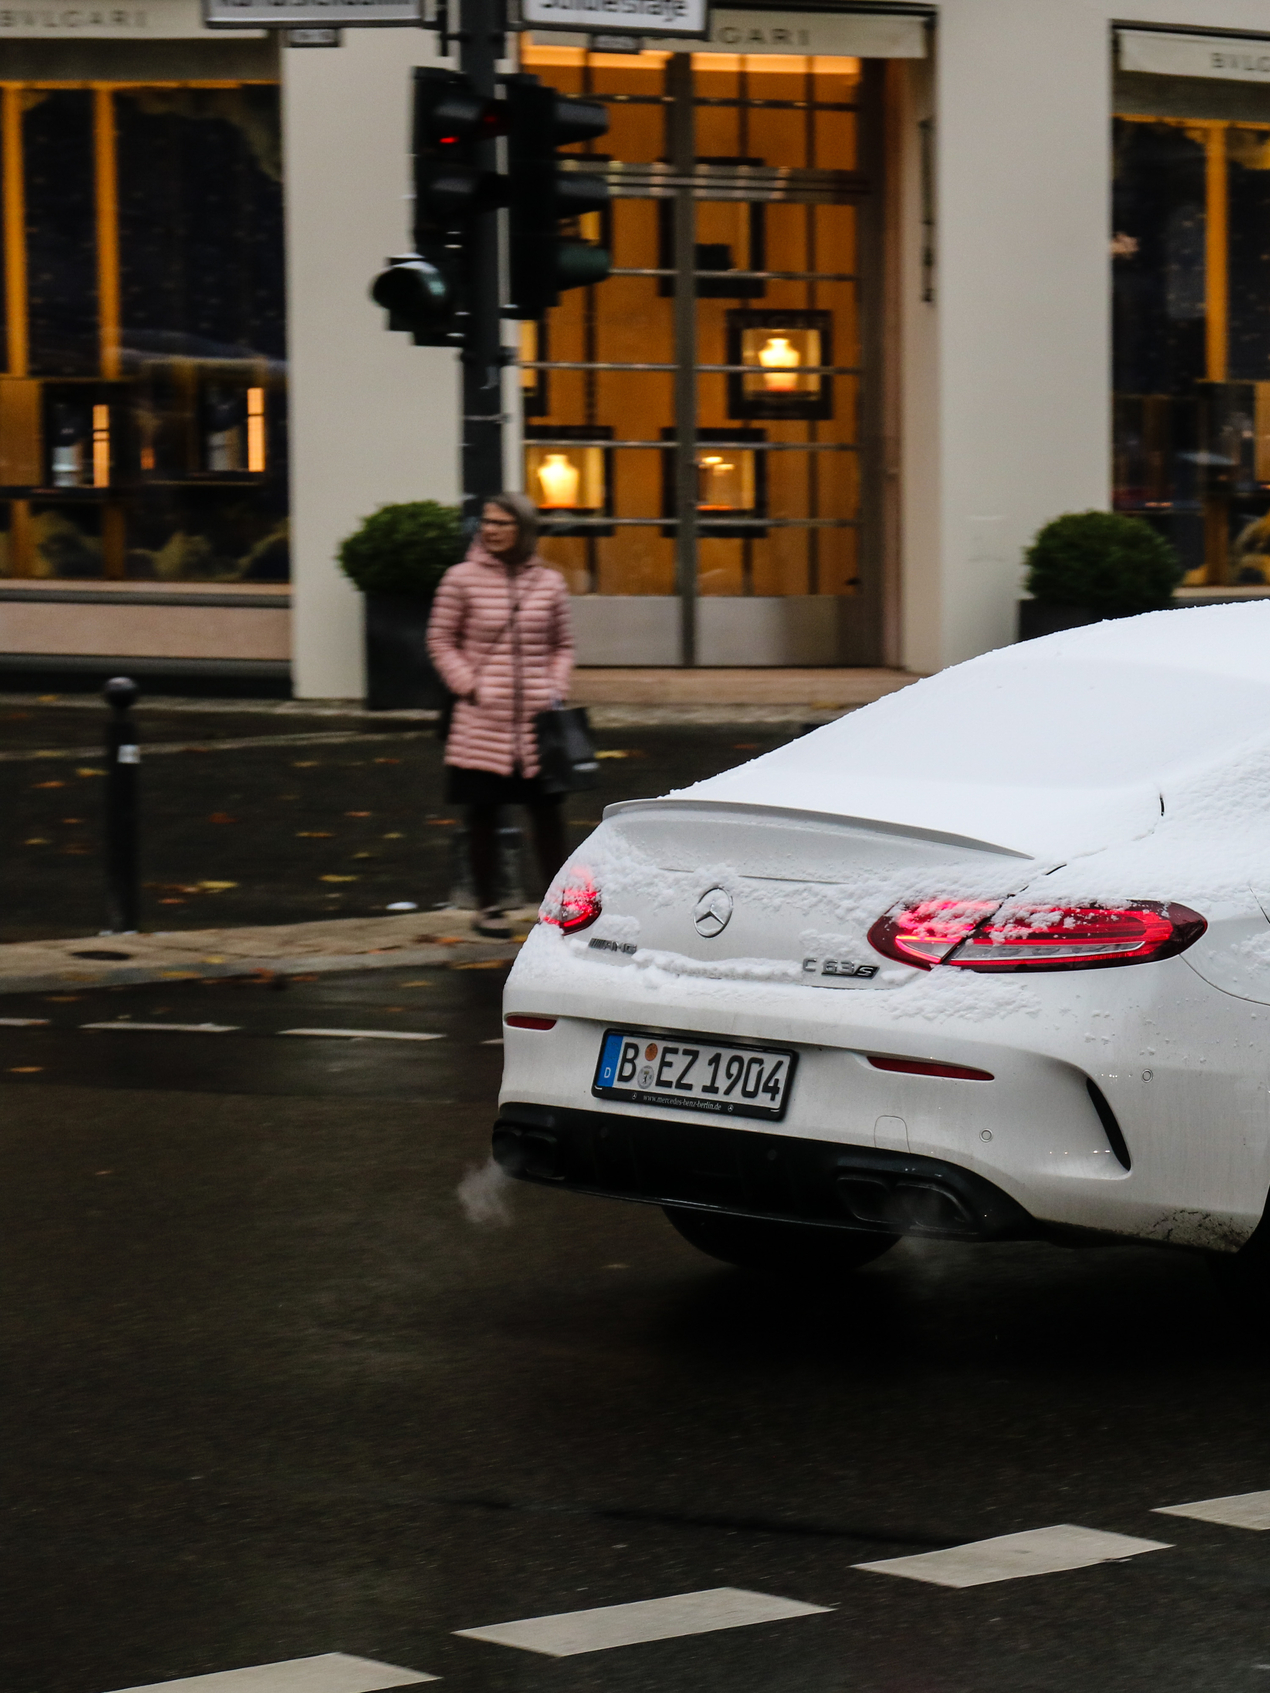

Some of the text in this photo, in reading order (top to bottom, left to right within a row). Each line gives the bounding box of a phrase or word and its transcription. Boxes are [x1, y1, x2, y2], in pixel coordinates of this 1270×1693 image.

[802, 957, 817, 972] C
[603, 1066, 611, 1078] D
[617, 1041, 784, 1102] B EZ 1904
[643, 1094, 722, 1111] www.mercedes-benz-berlin.de
